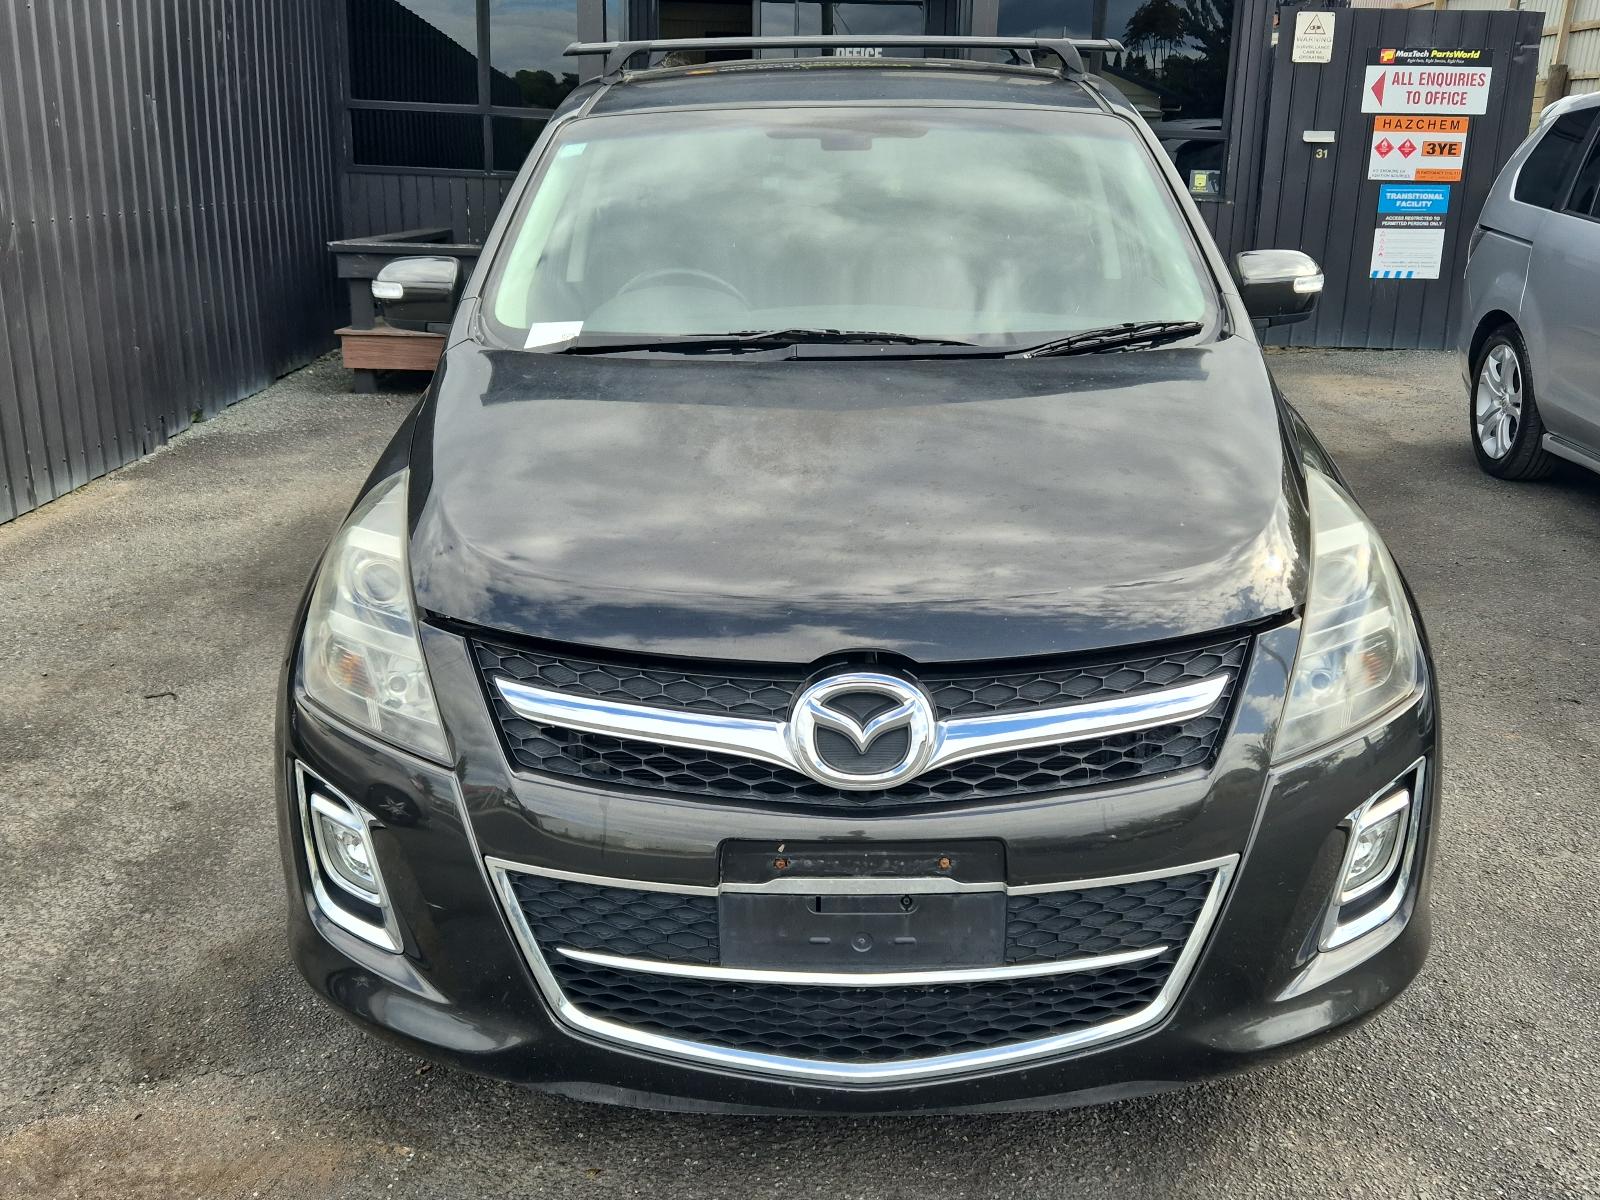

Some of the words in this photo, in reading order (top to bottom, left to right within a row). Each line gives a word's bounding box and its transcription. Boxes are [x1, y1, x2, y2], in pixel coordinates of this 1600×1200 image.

[1431, 50, 1480, 58] PartsWorld
[1392, 72, 1414, 85] ALL
[1419, 72, 1486, 88] ENQUIRIES
[1406, 91, 1420, 104] TO
[1425, 91, 1468, 106] OFFICE
[1382, 118, 1460, 130] HAZCHEM
[1316, 148, 1328, 158] 31
[1426, 142, 1458, 156] 3YE
